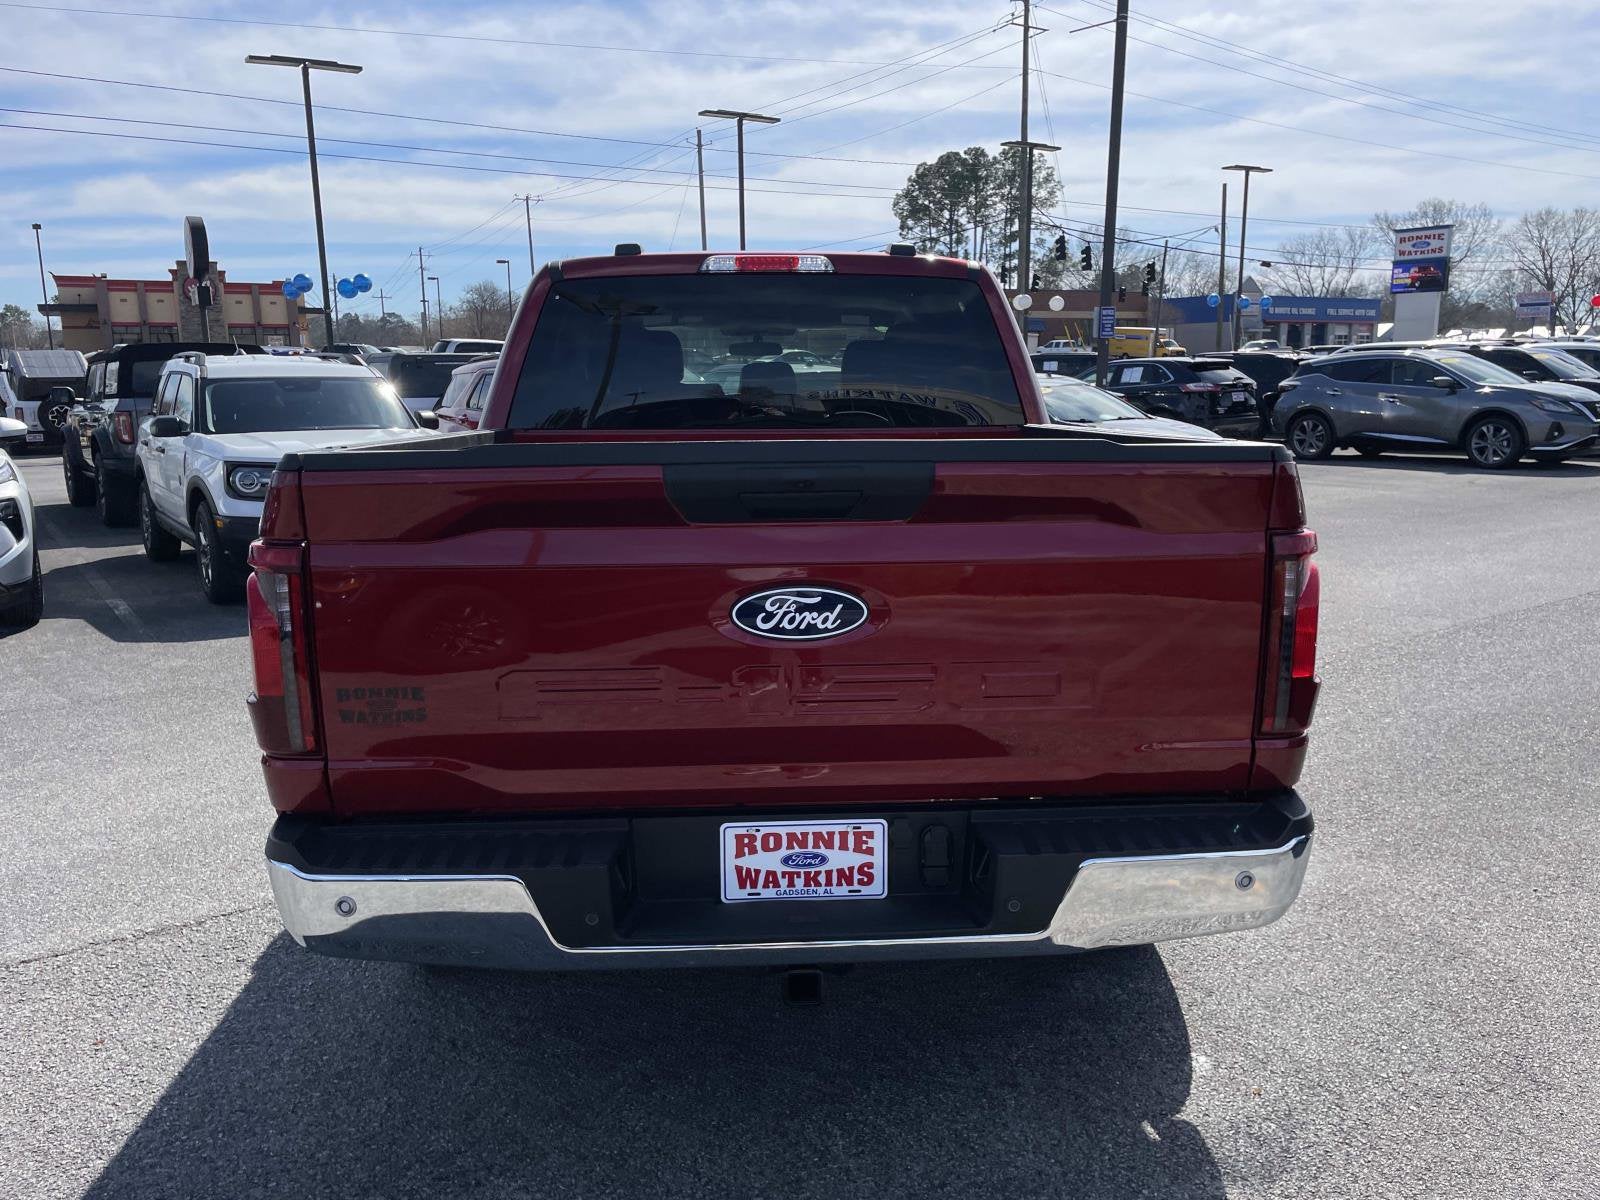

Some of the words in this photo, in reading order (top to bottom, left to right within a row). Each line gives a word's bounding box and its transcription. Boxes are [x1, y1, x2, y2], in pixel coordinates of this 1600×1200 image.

[1399, 233, 1445, 244] RONNIE
[1398, 246, 1444, 257] WATKINS
[1366, 309, 1376, 317] CARE
[756, 595, 844, 630] Ford
[336, 687, 425, 703] RONNIE
[338, 707, 428, 724] WATKINS
[734, 830, 875, 859] RONNIE
[788, 854, 822, 866] Ford
[734, 862, 875, 890] WATKINS
[775, 888, 822, 897] GADSDEN,
[822, 888, 835, 896] AL
